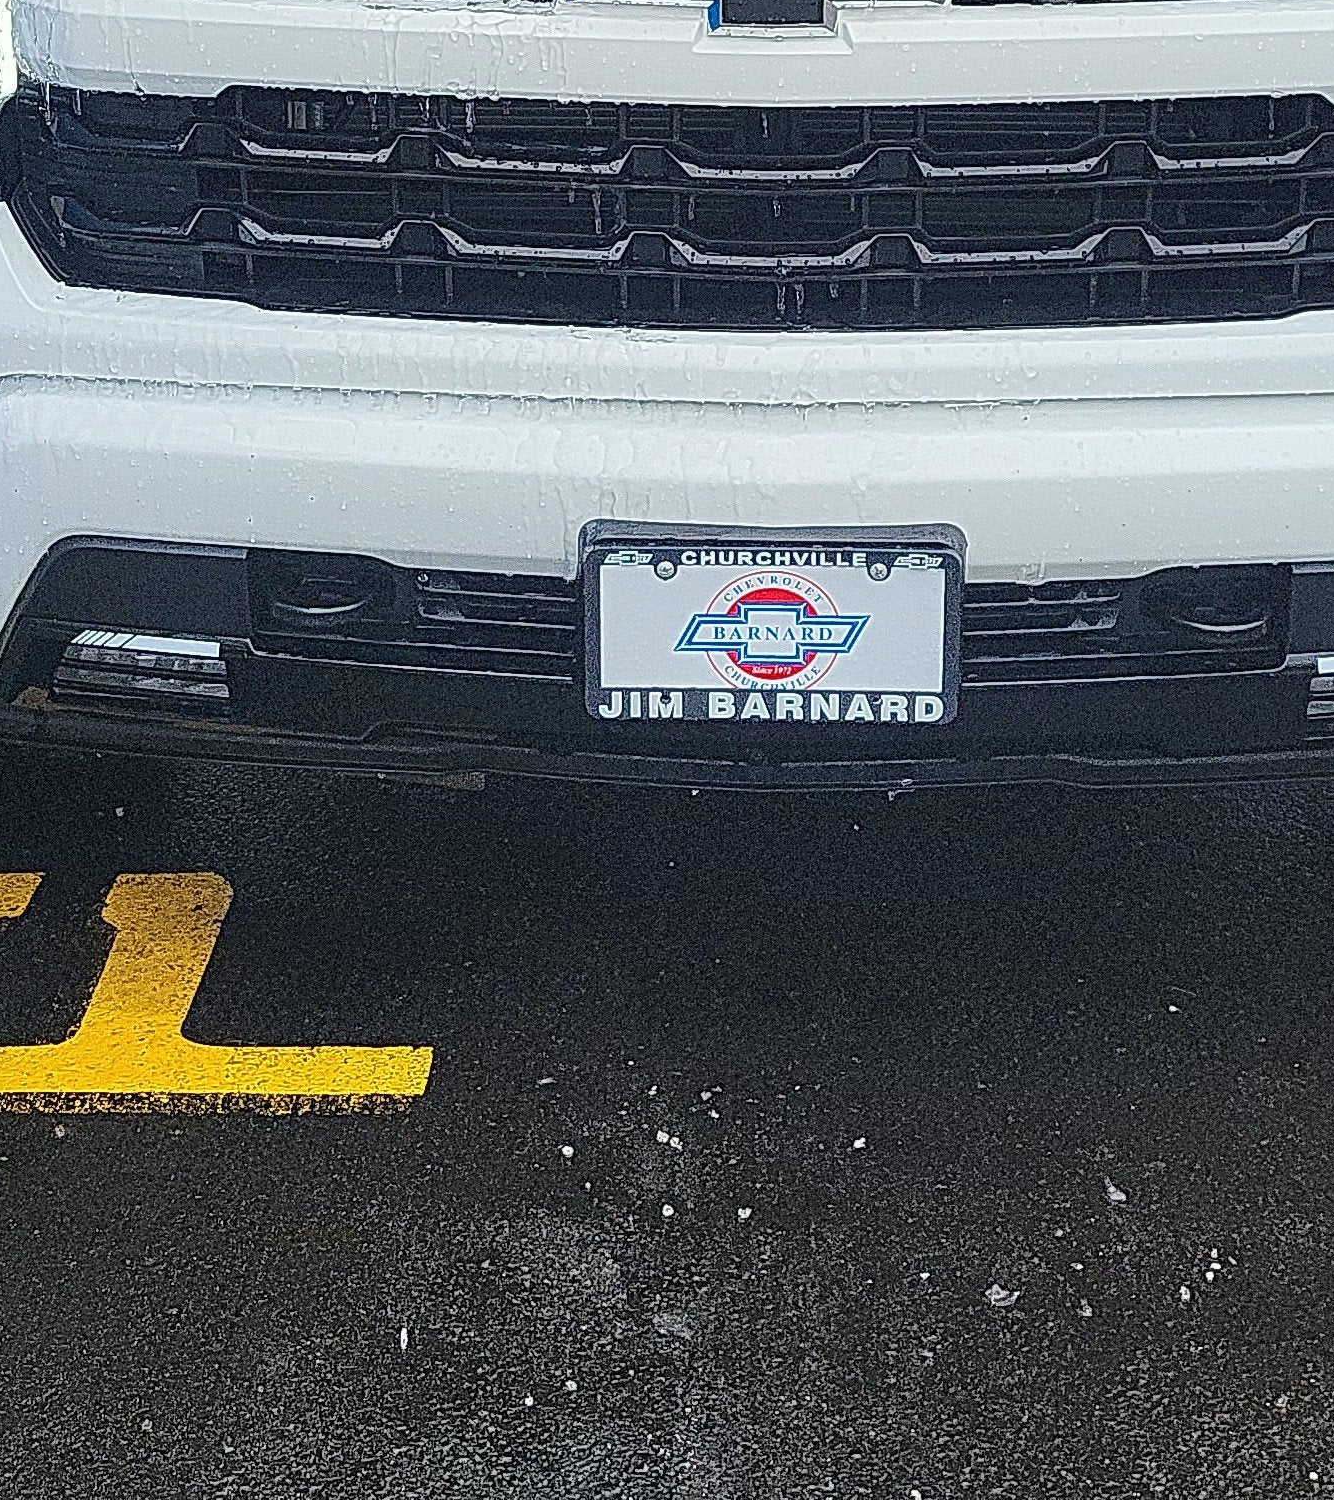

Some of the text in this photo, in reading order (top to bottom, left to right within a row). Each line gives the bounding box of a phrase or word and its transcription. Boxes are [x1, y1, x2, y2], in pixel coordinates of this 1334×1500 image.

[680, 550, 868, 567] CHURCHVILLE
[723, 575, 824, 603] CHEVROLET
[713, 626, 833, 641] BARNARD
[598, 691, 945, 723] JIM BARNARD
